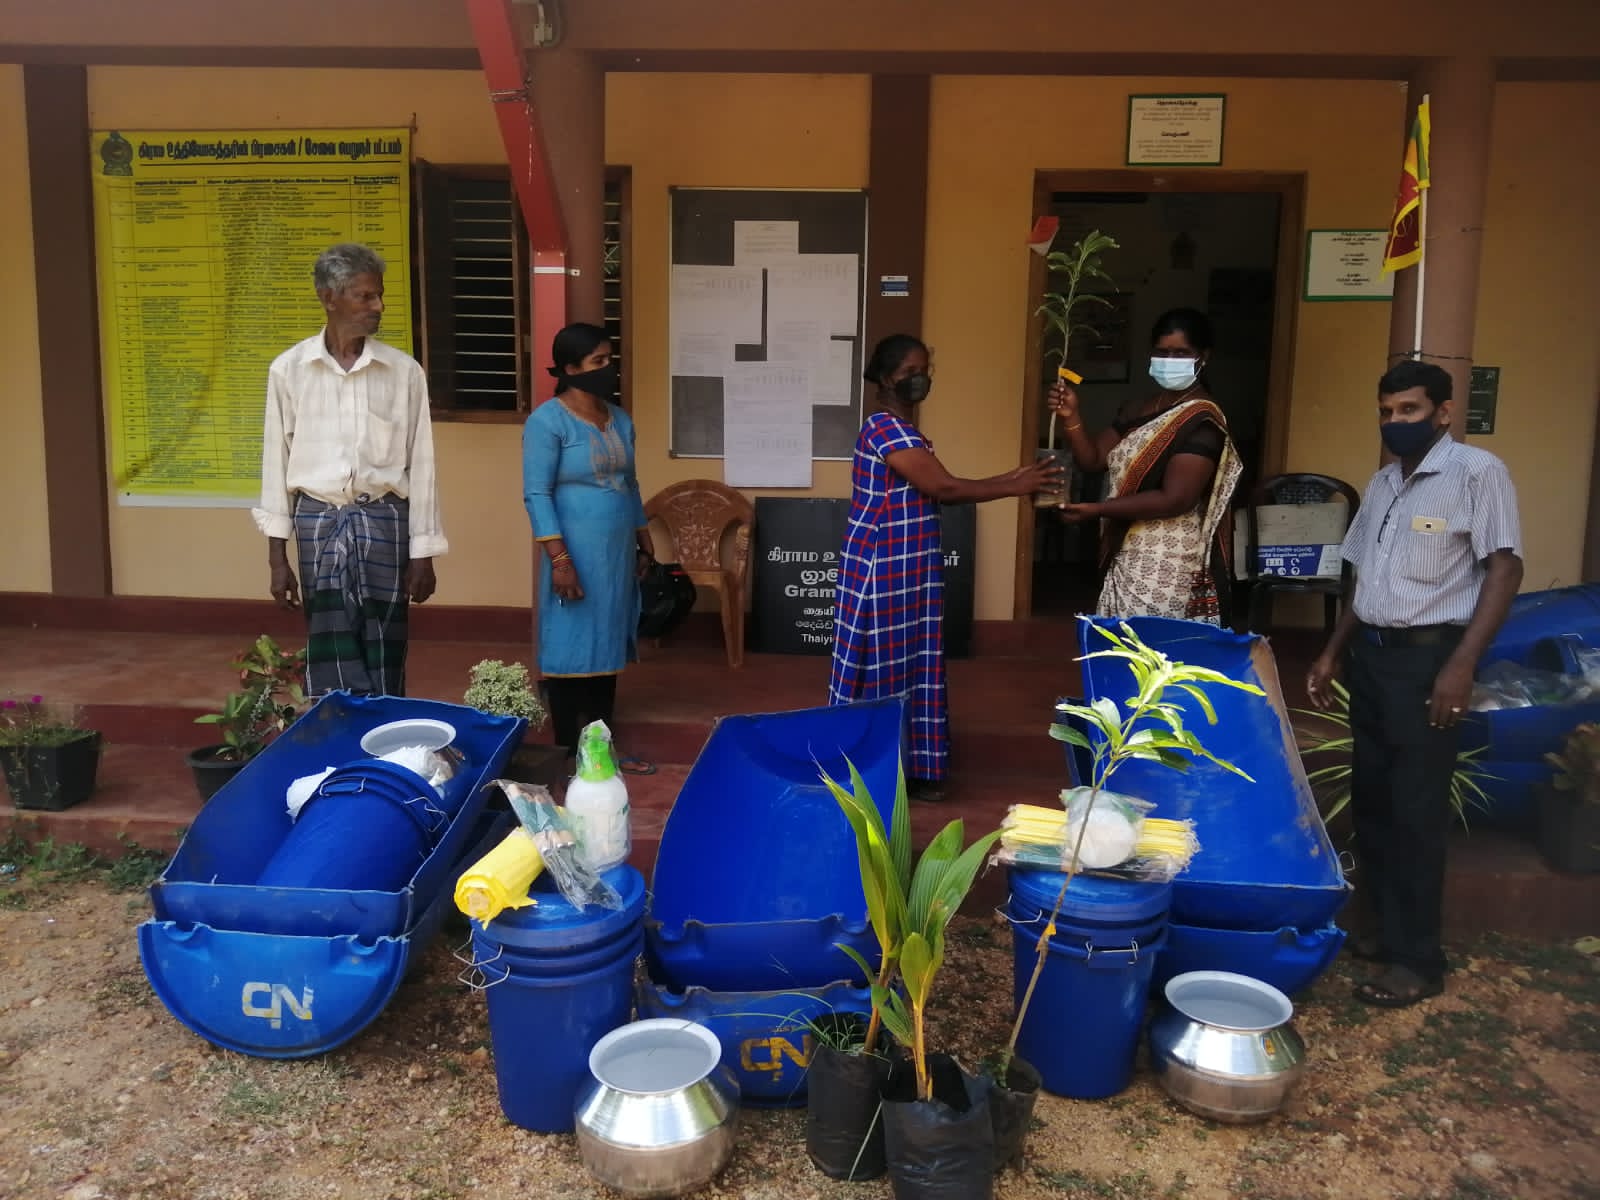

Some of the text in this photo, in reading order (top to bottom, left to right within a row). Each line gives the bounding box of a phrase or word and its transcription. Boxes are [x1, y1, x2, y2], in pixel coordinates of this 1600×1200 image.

[139, 142, 165, 159] கிராம
[767, 546, 819, 563] கிராம
[784, 584, 837, 599] Gram
[803, 606, 836, 617] தையி
[800, 633, 834, 646] Thaiyi
